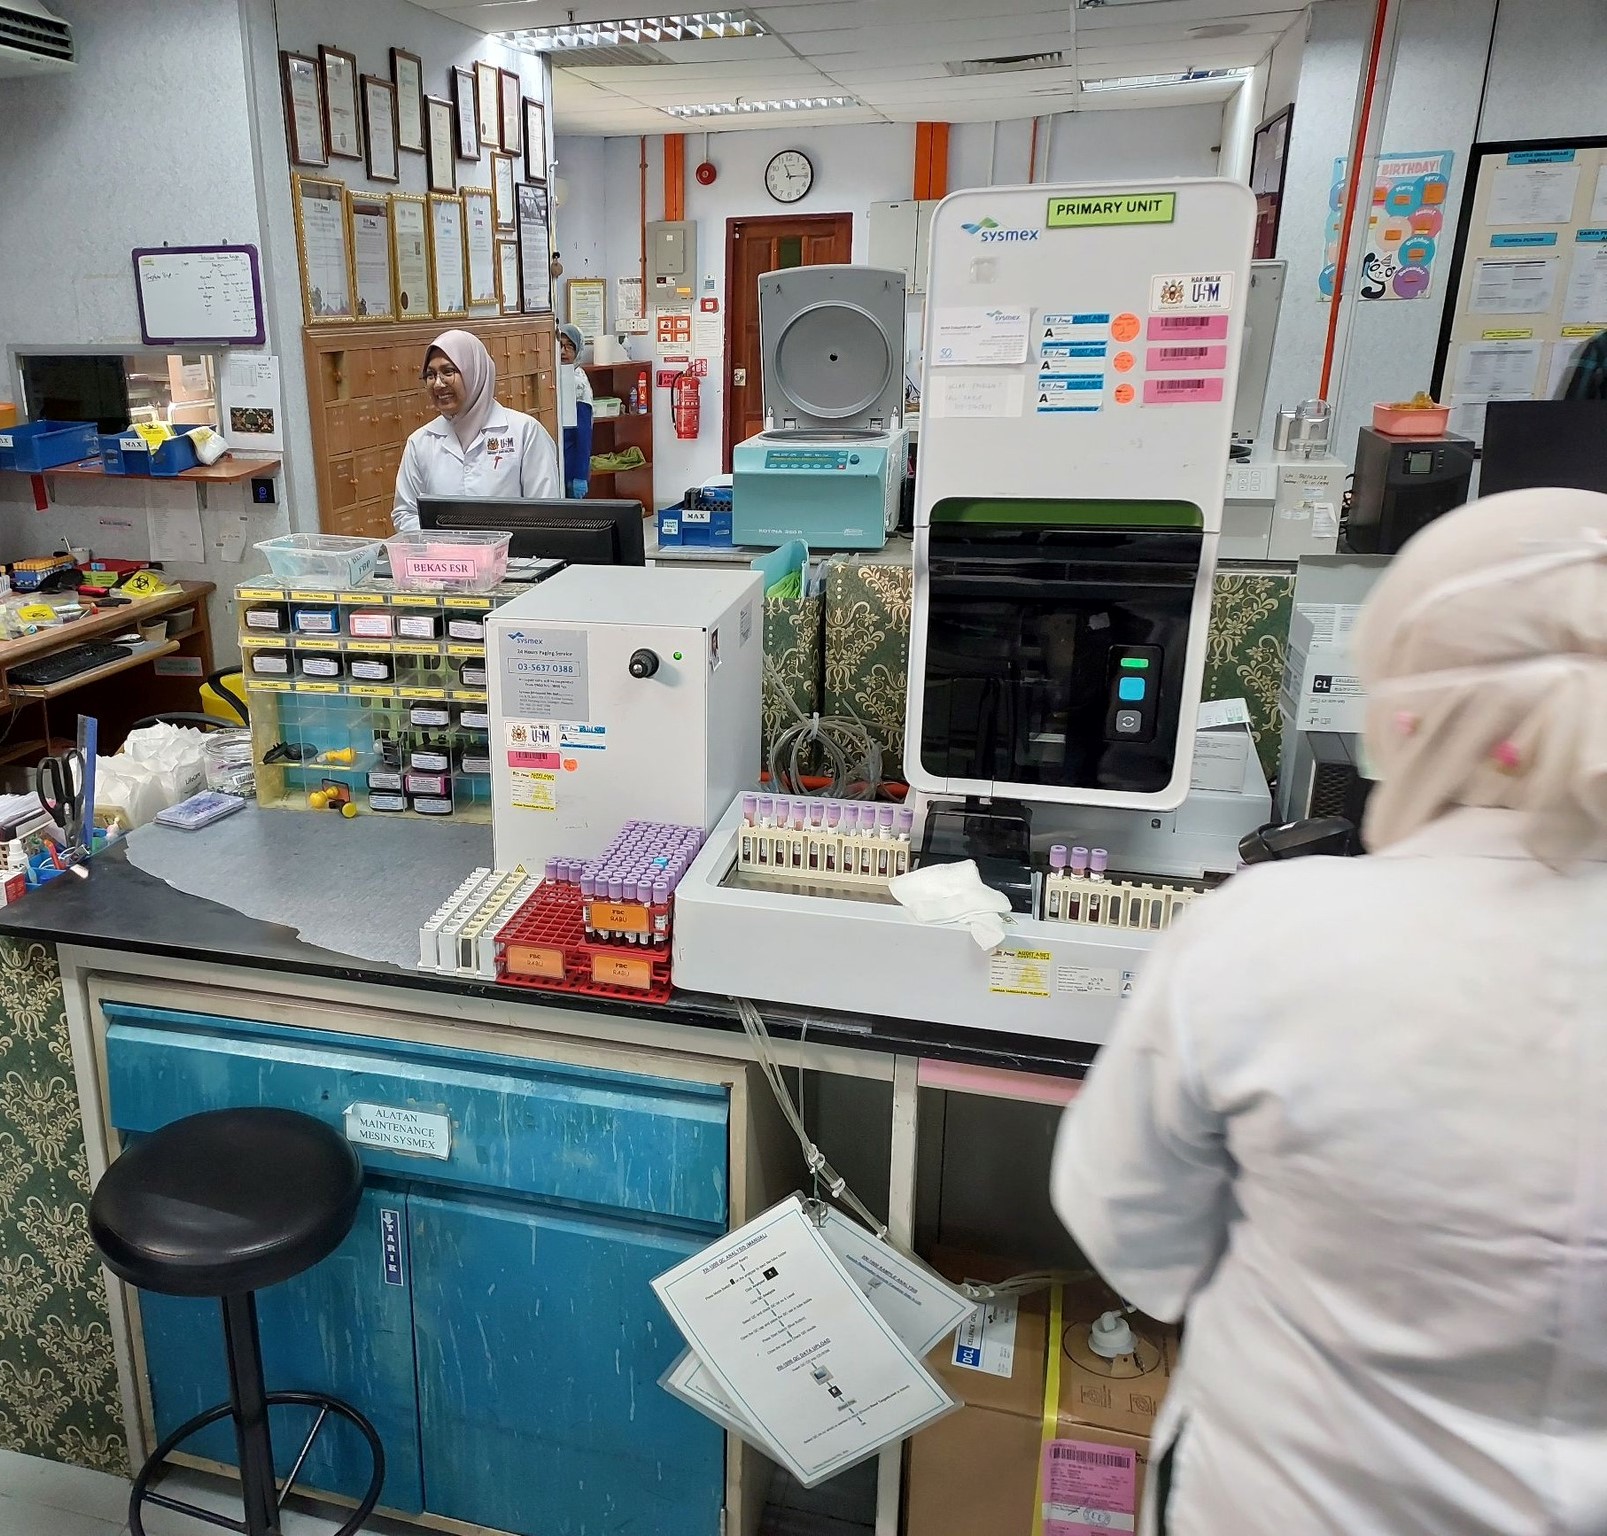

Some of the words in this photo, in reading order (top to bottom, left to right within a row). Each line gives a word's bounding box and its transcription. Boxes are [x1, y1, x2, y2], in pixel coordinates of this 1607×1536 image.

[1056, 200, 1123, 216] PRIMARY
[1126, 200, 1163, 213] UNIT
[981, 228, 1040, 242] sysmex
[1044, 328, 1054, 338] A
[1041, 360, 1051, 370] A
[1038, 393, 1048, 403] A
[413, 563, 447, 573] BEKAS
[450, 564, 468, 573] ESR
[517, 662, 550, 672] 03-5637
[552, 665, 574, 673] 0388
[1314, 679, 1330, 689] CL
[560, 733, 568, 741] A
[374, 1108, 419, 1122] ALATAN
[359, 1117, 435, 1138] MAINTENANCE
[359, 1130, 392, 1143] MESIN
[392, 1134, 436, 1150] SYSMEX
[386, 1224, 398, 1273] TARIK
[962, 1348, 974, 1365] DCL
